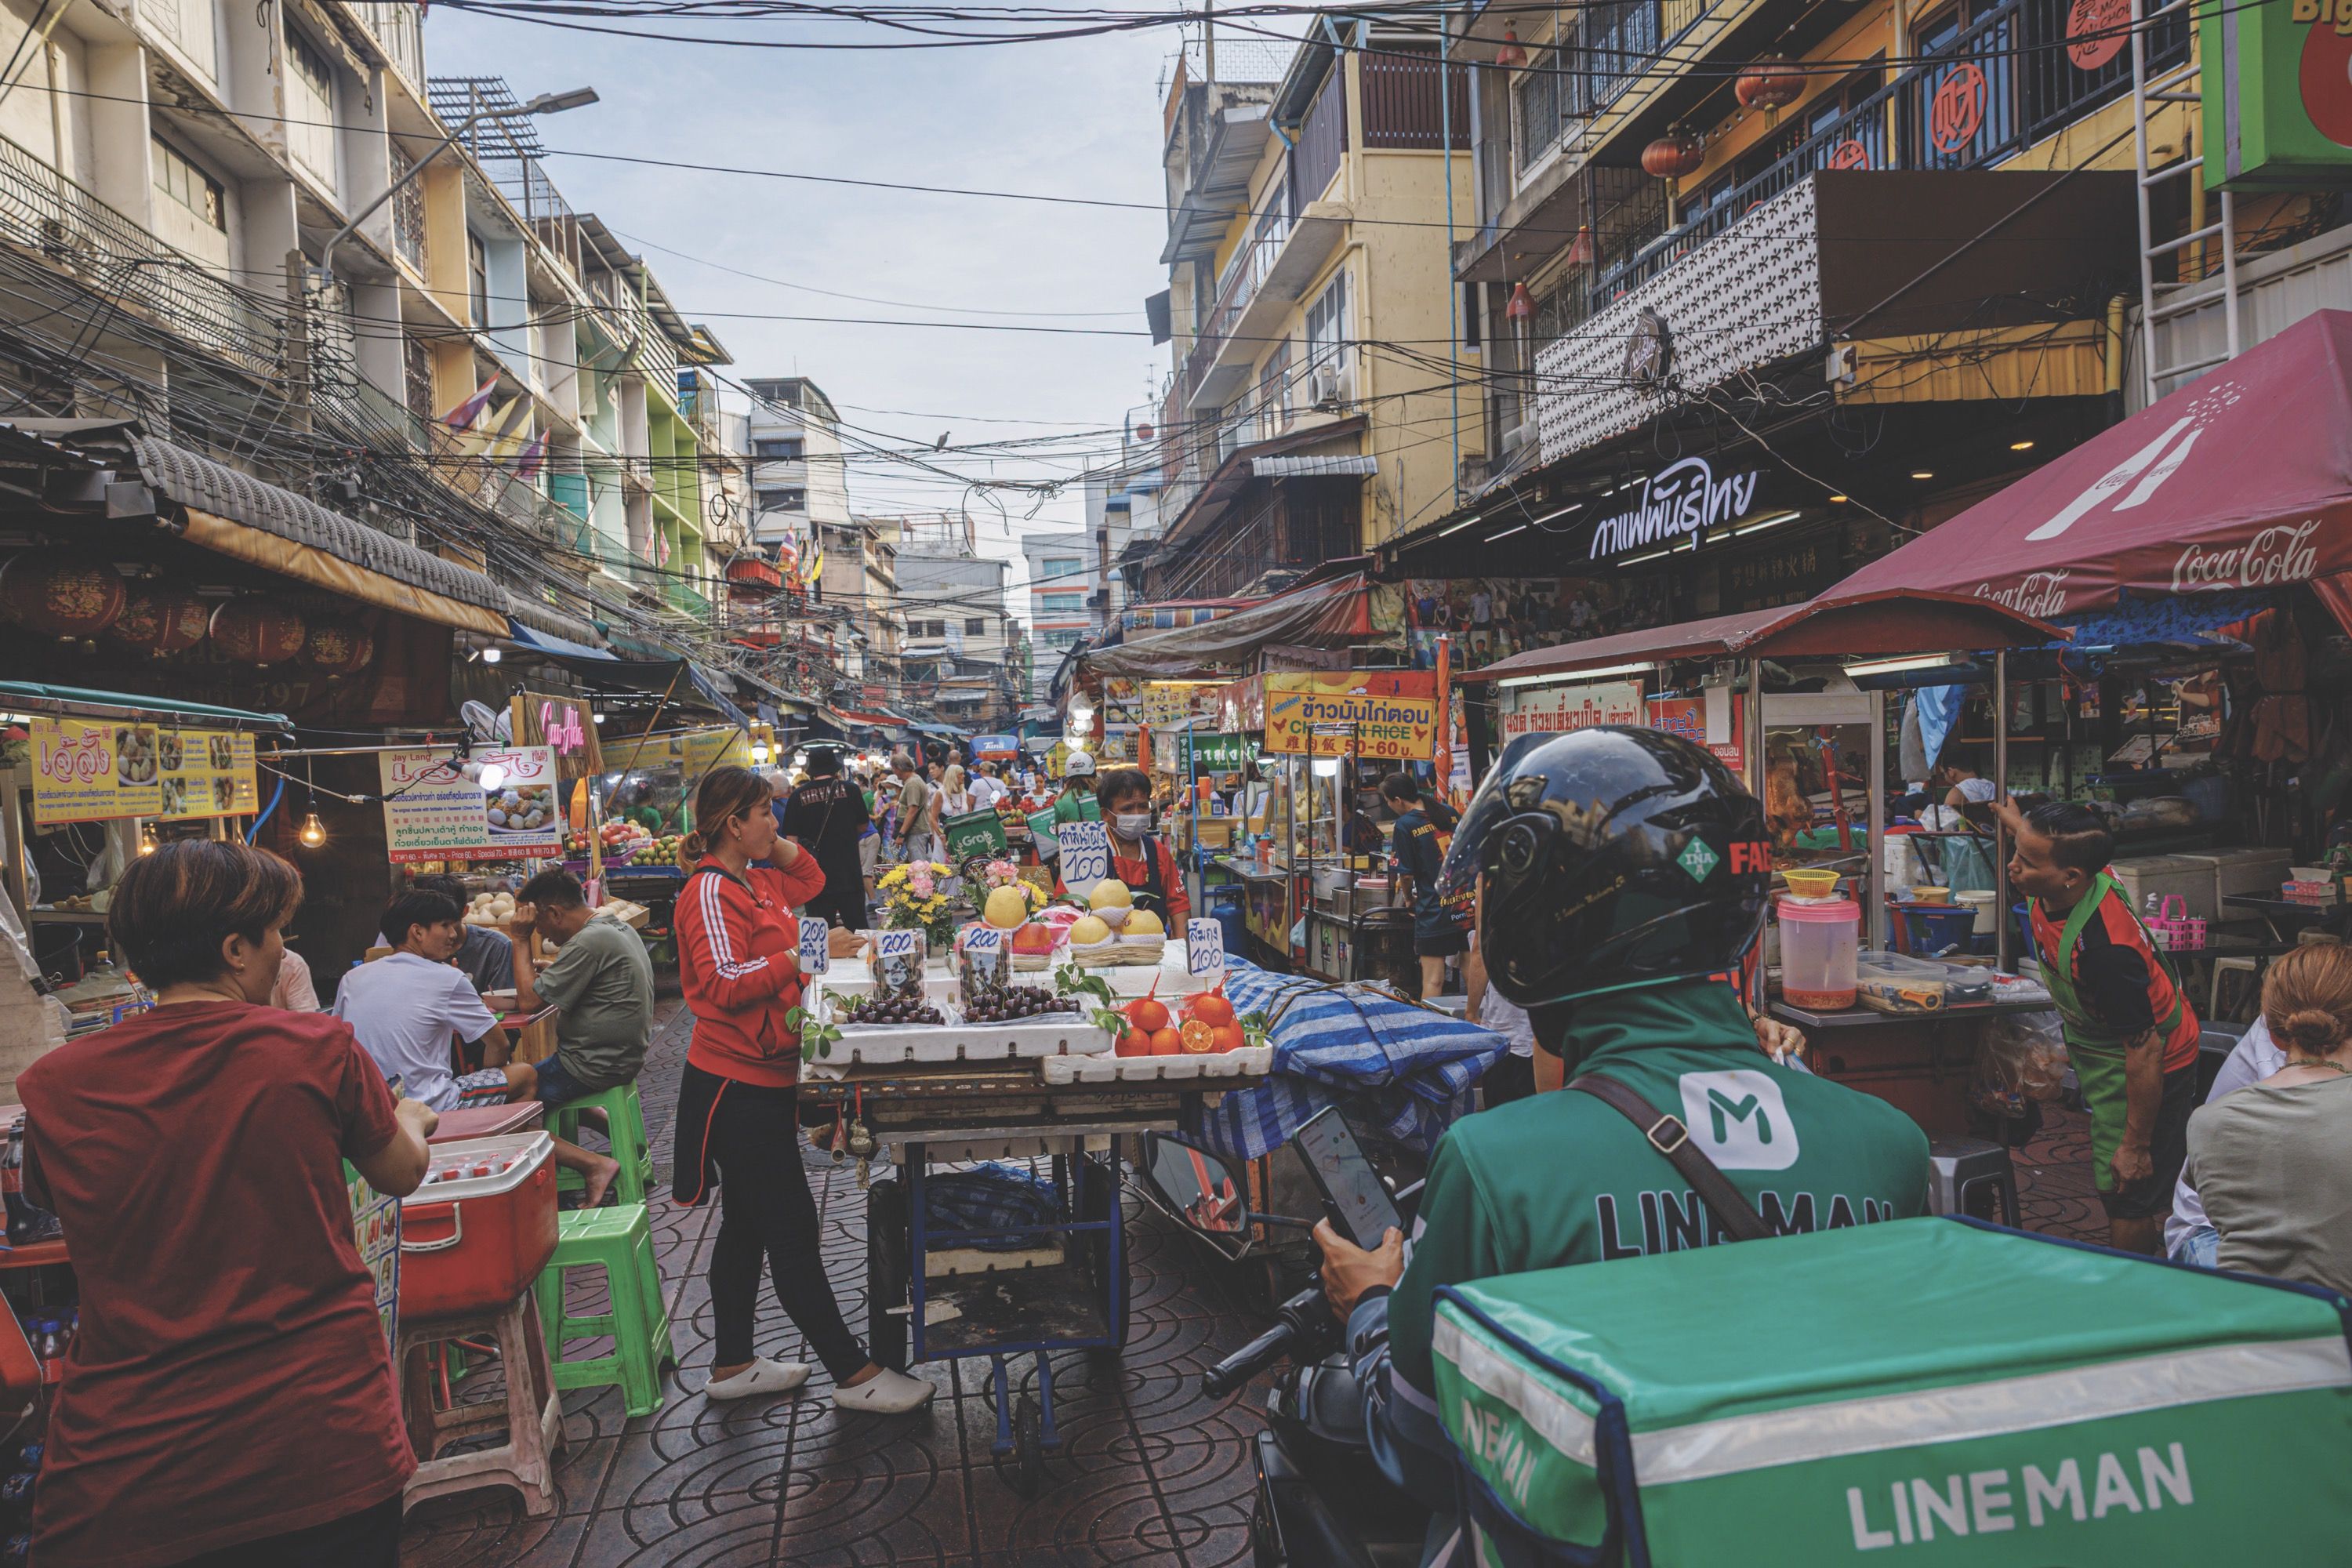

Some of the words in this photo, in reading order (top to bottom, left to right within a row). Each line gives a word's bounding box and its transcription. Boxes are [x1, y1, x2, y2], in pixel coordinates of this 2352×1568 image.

[2170, 519, 2322, 594] Coca-Cola
[1302, 696, 1429, 724] ข้าวมันไก่ตอน
[1371, 724, 1411, 739] RICE
[392, 753, 407, 763] Jay
[410, 753, 431, 764] Lang
[1344, 739, 1398, 756] 50-60
[477, 850, 495, 859] Special
[1065, 854, 1105, 884] 100
[800, 920, 826, 942] 200
[967, 927, 999, 948] 200
[882, 932, 912, 955] 200
[1192, 946, 1222, 974] 100
[1846, 1468, 2016, 1551] LINE
[2021, 1441, 2194, 1527] MAN
